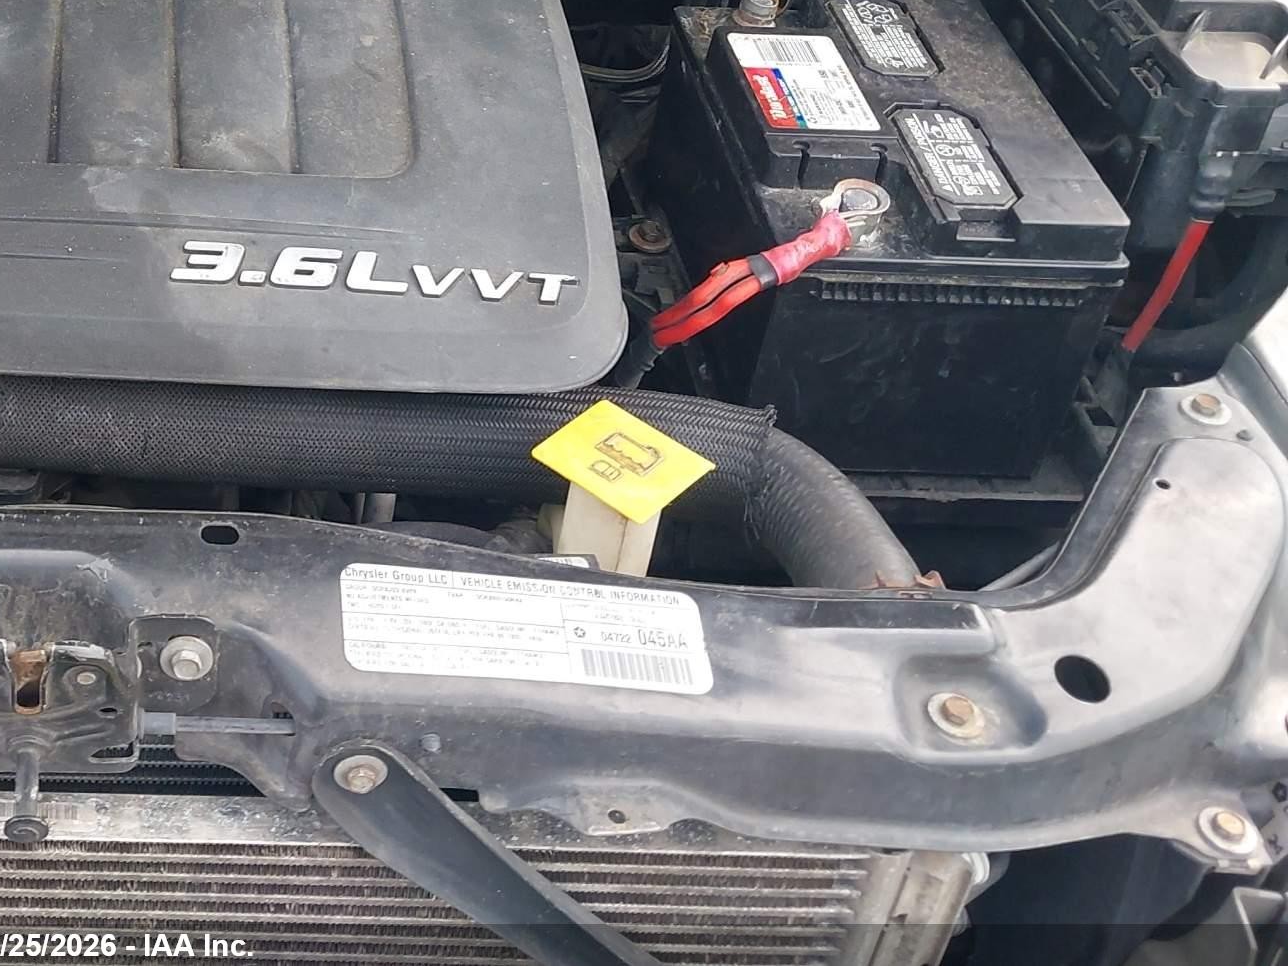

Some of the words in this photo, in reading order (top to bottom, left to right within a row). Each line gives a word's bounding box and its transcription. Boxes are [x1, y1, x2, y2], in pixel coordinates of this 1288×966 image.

[905, 118, 928, 145] POISON
[923, 153, 948, 184] DANGER
[344, 567, 388, 579] Chrysler
[392, 570, 424, 583] Group
[428, 575, 448, 585] LLC
[461, 577, 502, 589] VEHICLE
[507, 581, 555, 594] EMISSION
[560, 585, 606, 599] CONTROL
[610, 591, 679, 605] INFORMATION
